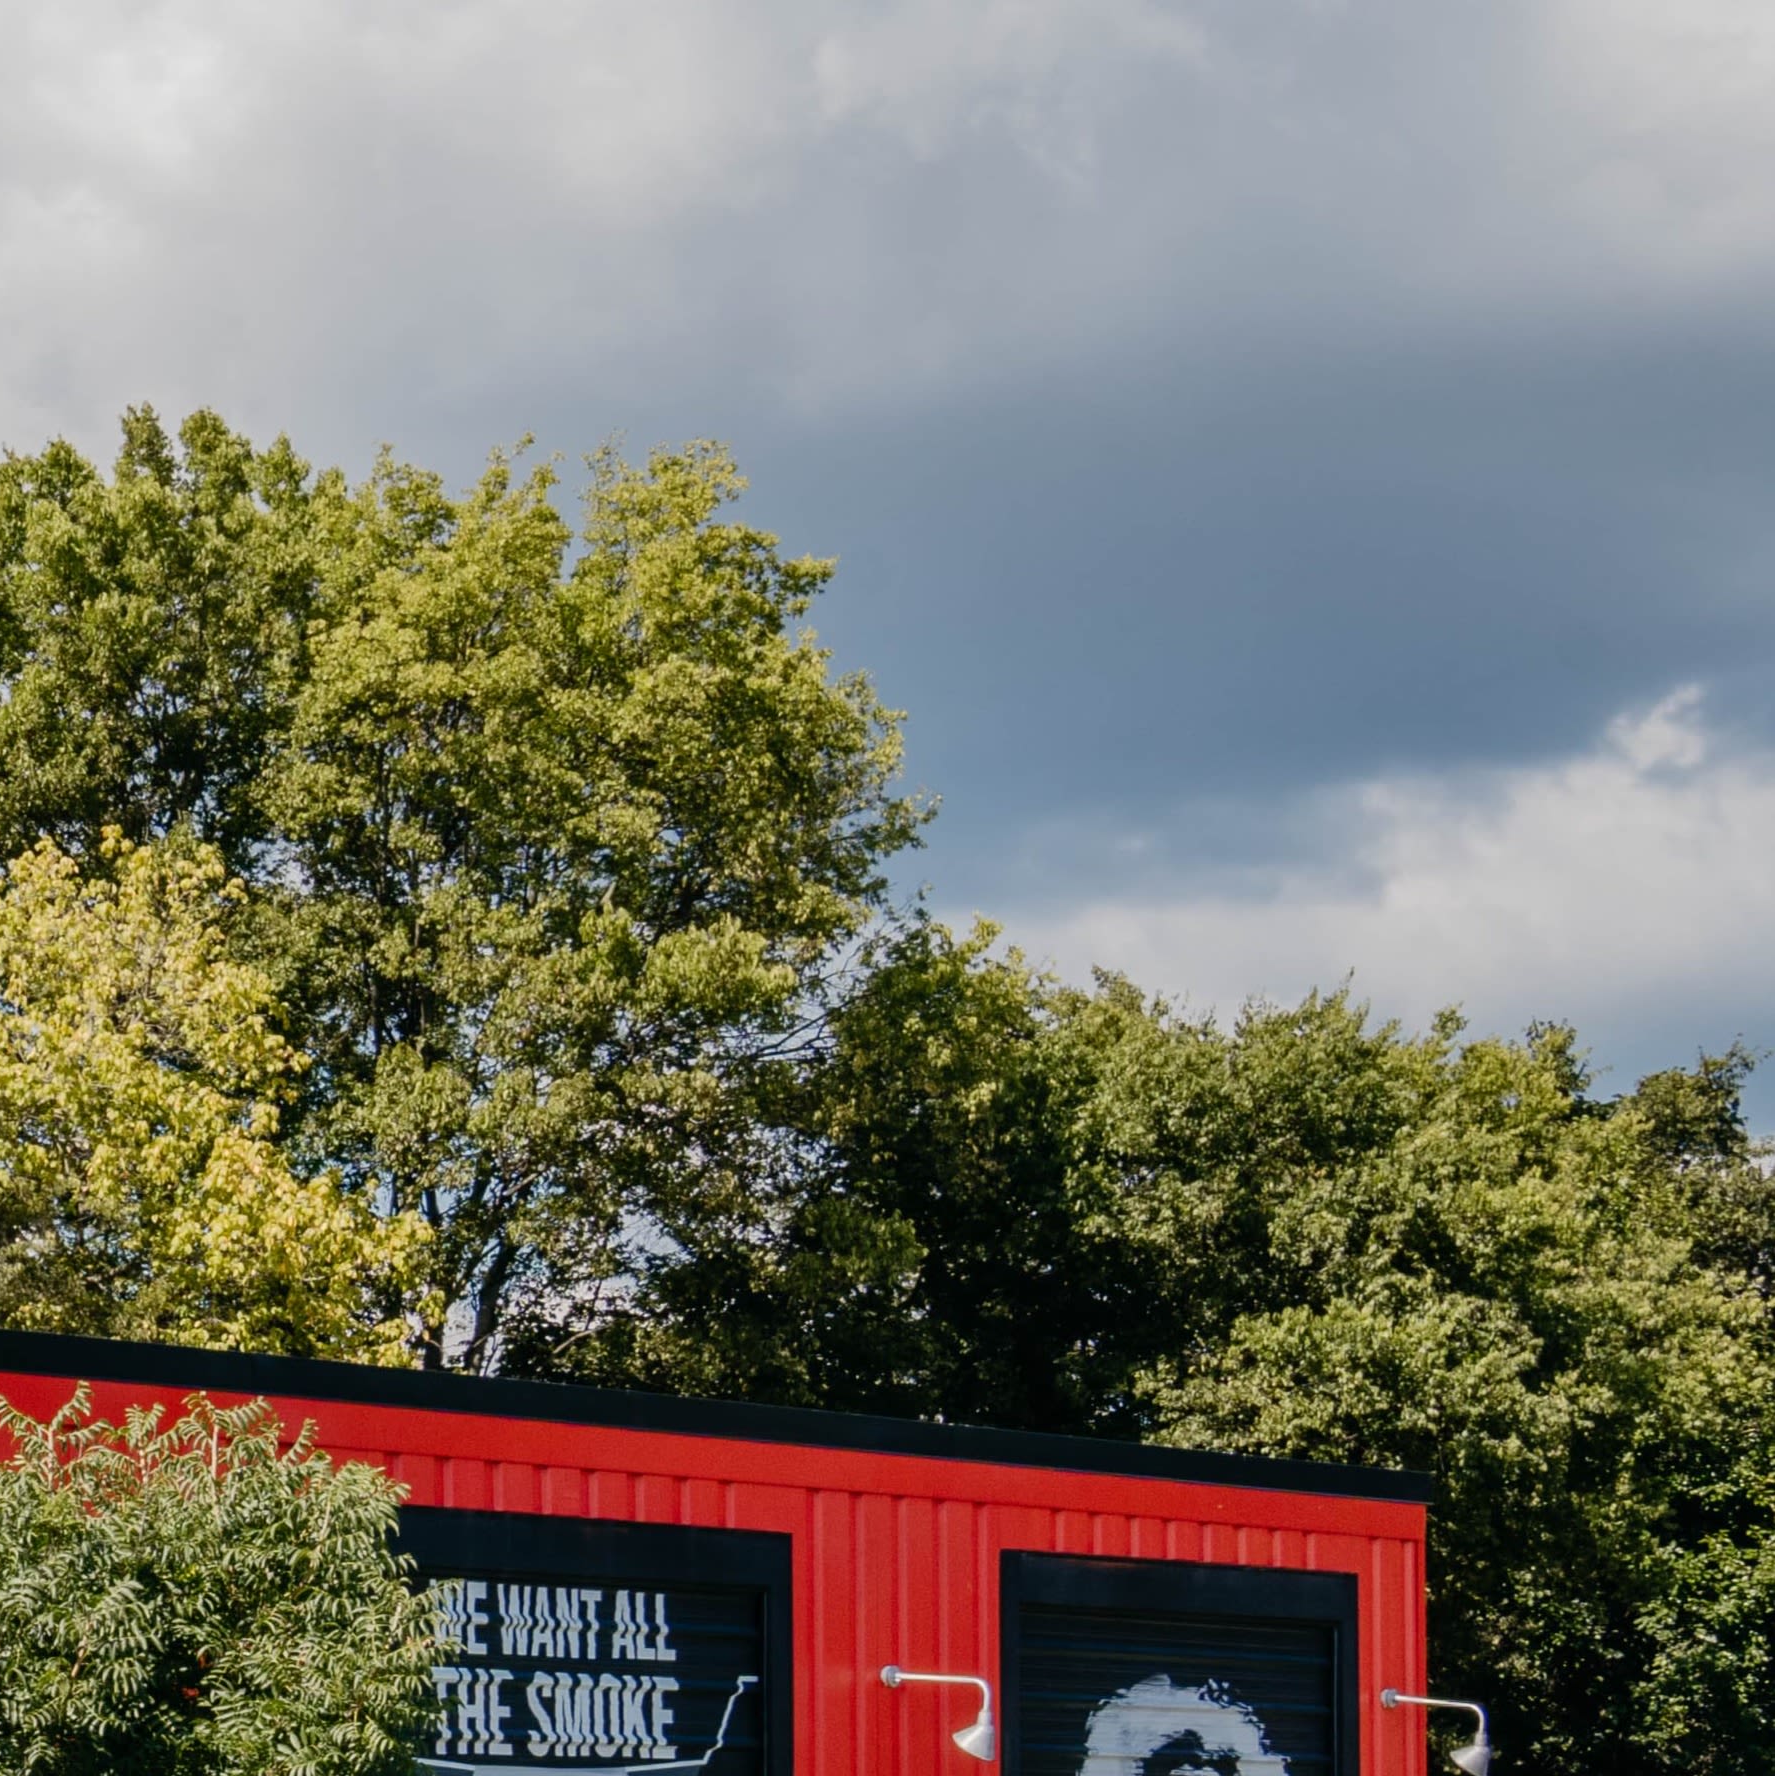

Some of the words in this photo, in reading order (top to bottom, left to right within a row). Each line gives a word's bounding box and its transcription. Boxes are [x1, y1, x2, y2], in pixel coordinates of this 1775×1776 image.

[429, 1579, 488, 1655] WE
[497, 1583, 603, 1660] WANT
[611, 1589, 677, 1662] ALL
[430, 1666, 514, 1756] THE
[526, 1671, 680, 1760] SMOKE
